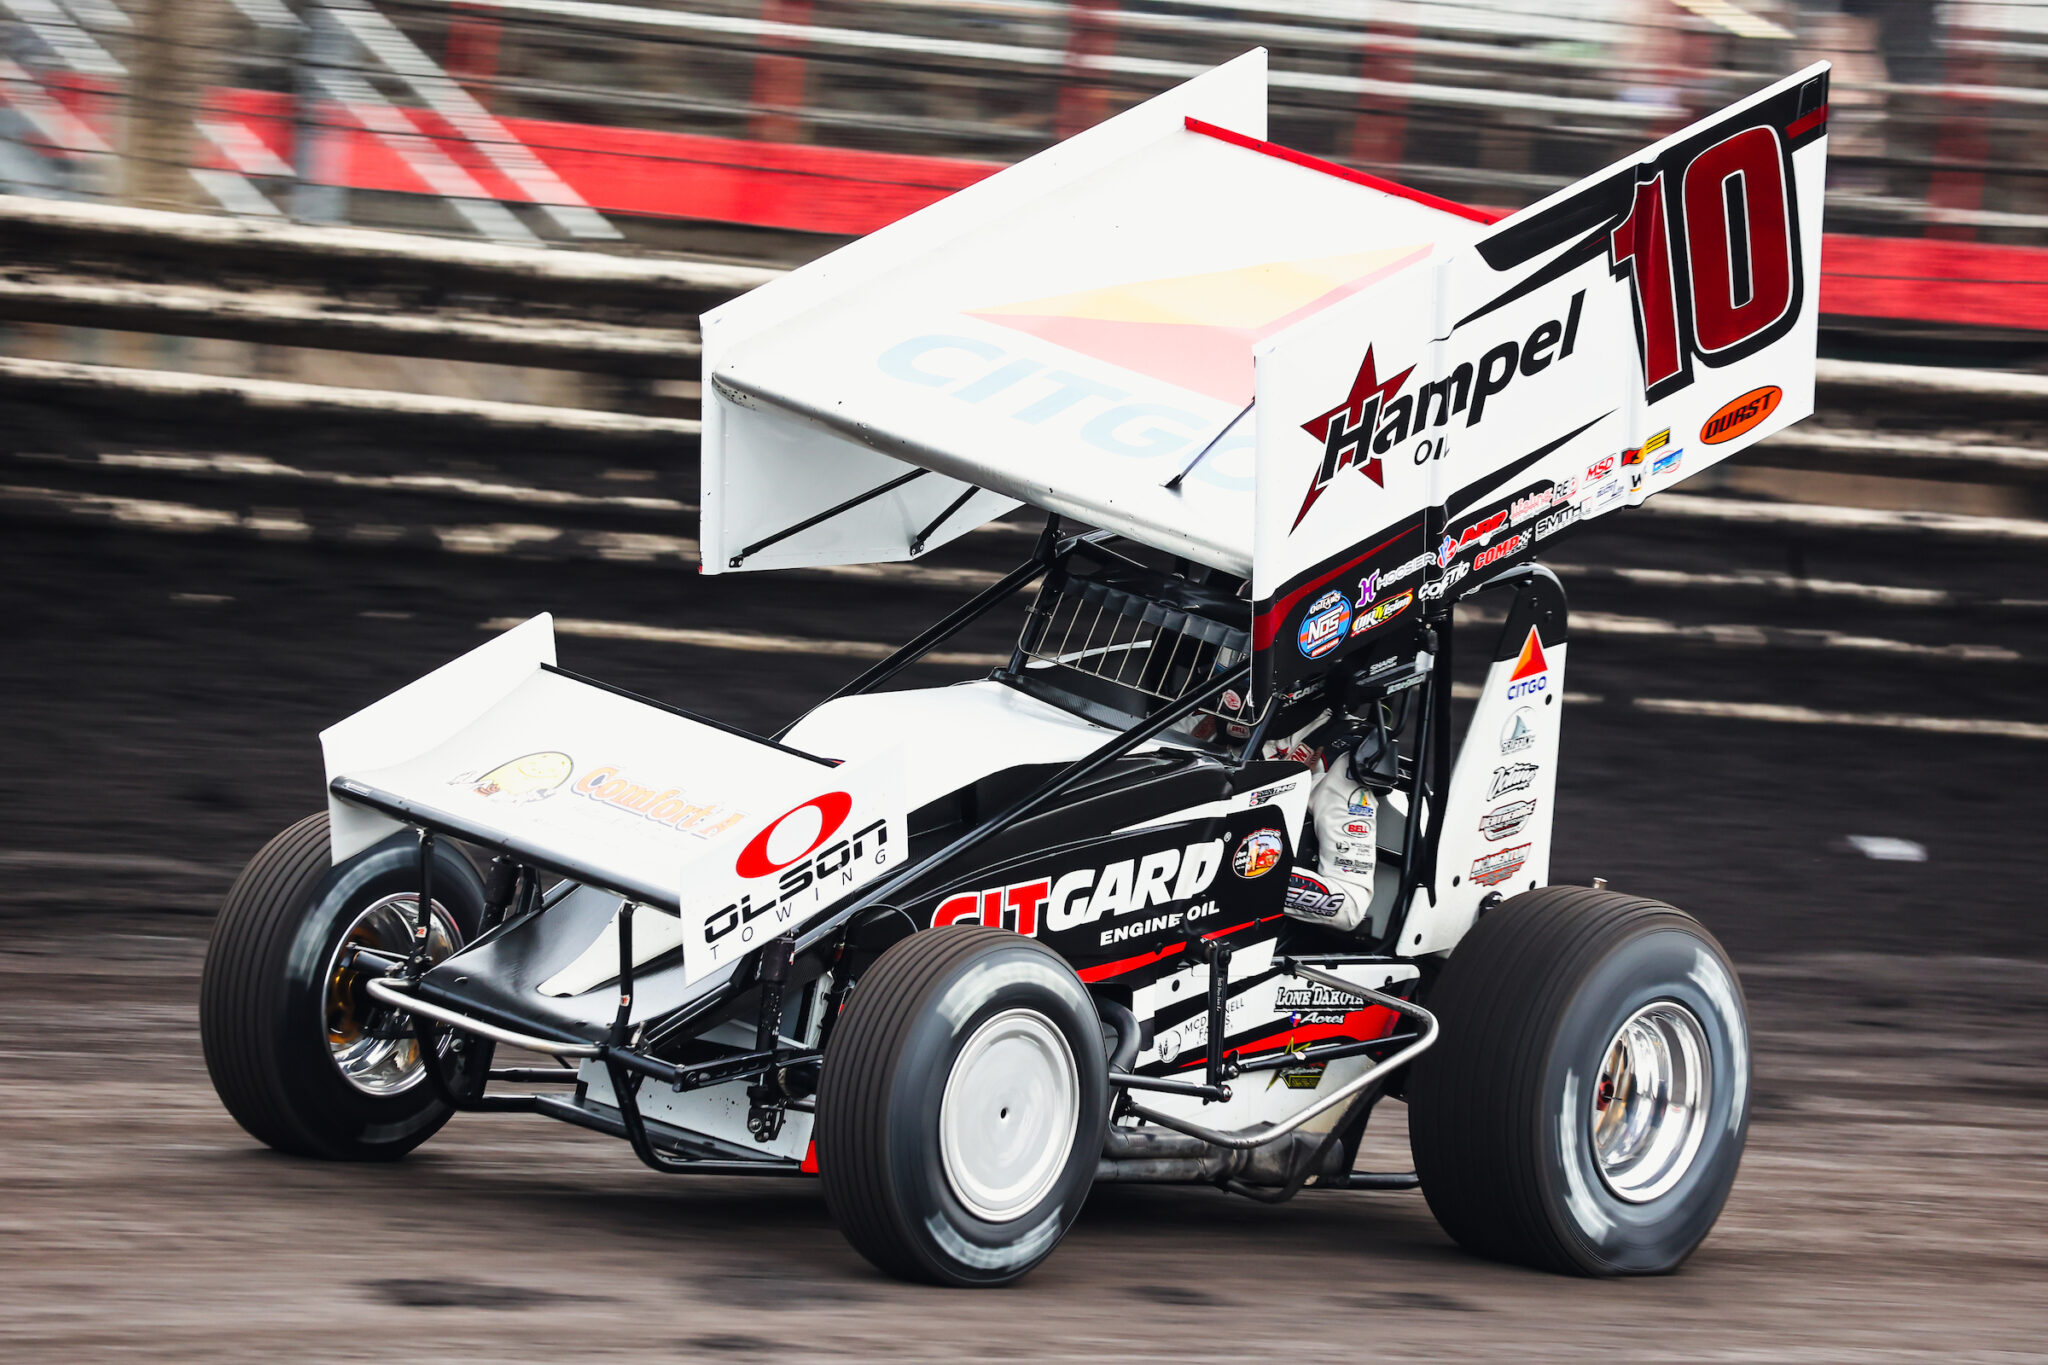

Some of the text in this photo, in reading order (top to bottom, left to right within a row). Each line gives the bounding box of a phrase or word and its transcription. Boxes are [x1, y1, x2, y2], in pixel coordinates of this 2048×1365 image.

[1608, 123, 1797, 392] 10
[1317, 288, 1587, 486] Hampel
[877, 334, 1256, 492] CITGO
[1705, 390, 1777, 441] DURST
[1413, 433, 1451, 466] OIL
[1585, 456, 1614, 482] MSD
[1459, 509, 1508, 547] ARP
[1376, 551, 1437, 590] HOOSIER
[1473, 535, 1521, 571] COMP
[1307, 603, 1344, 643] NOS
[1369, 655, 1399, 671] SHARP
[1507, 675, 1547, 700] CITGO
[574, 764, 718, 830] Comfort
[1347, 824, 1369, 834] BELL
[709, 848, 887, 961] TOWING
[930, 837, 1226, 939] CITGARD
[1100, 901, 1220, 947] ENGINE OIL
[1276, 986, 1313, 1007] LONE
[1300, 1011, 1345, 1025] Acres
